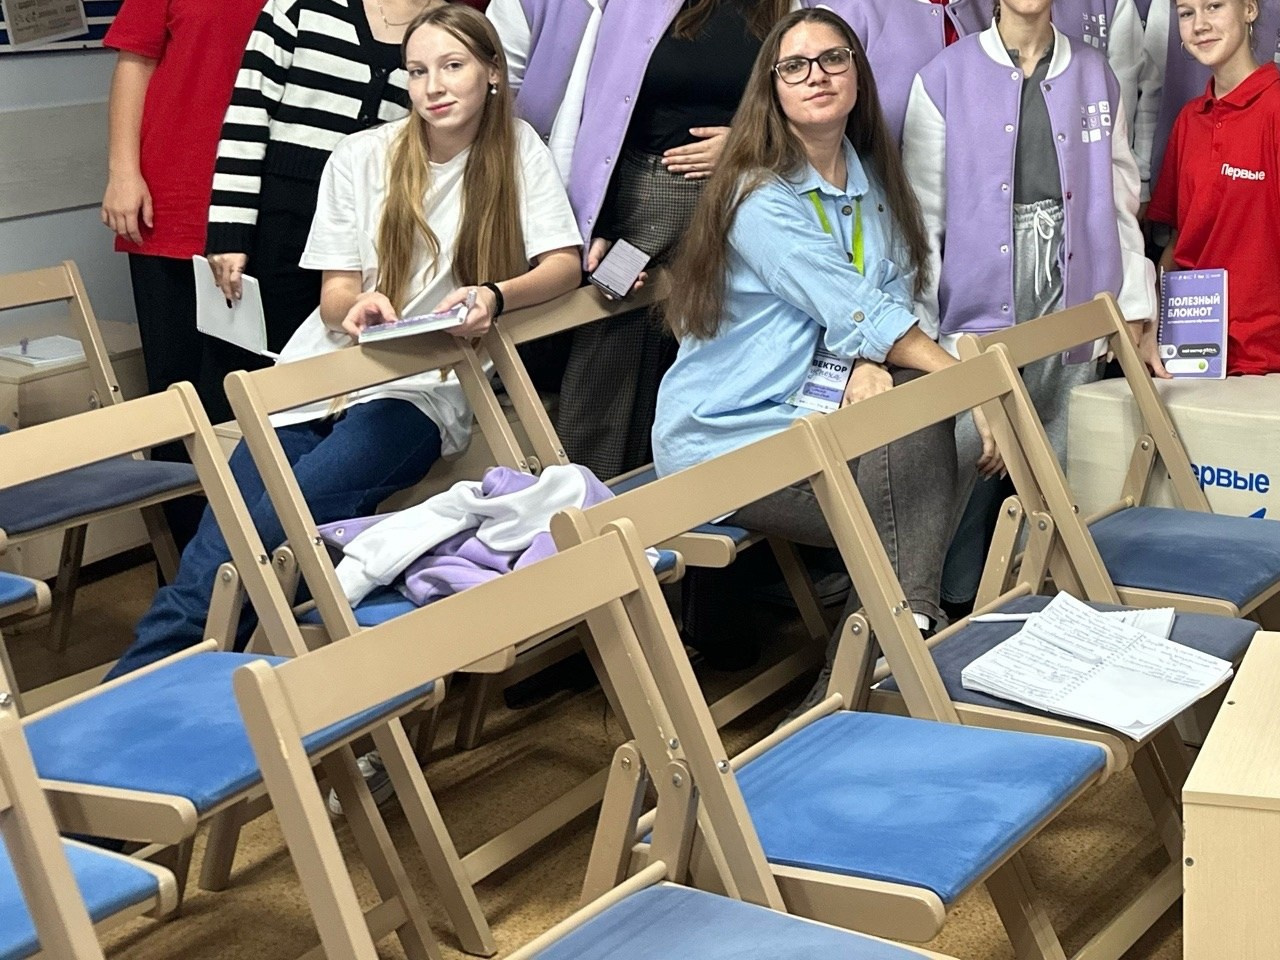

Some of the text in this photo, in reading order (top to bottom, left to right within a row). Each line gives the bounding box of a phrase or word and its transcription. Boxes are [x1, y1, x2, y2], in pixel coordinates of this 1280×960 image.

[1221, 163, 1266, 181] Первые
[1168, 293, 1221, 307] ПОЛЕЗНЫЙ
[1167, 307, 1213, 318] БЛОКНОТ
[812, 360, 848, 373] ВЕКТОР
[1190, 463, 1270, 494] ервые
